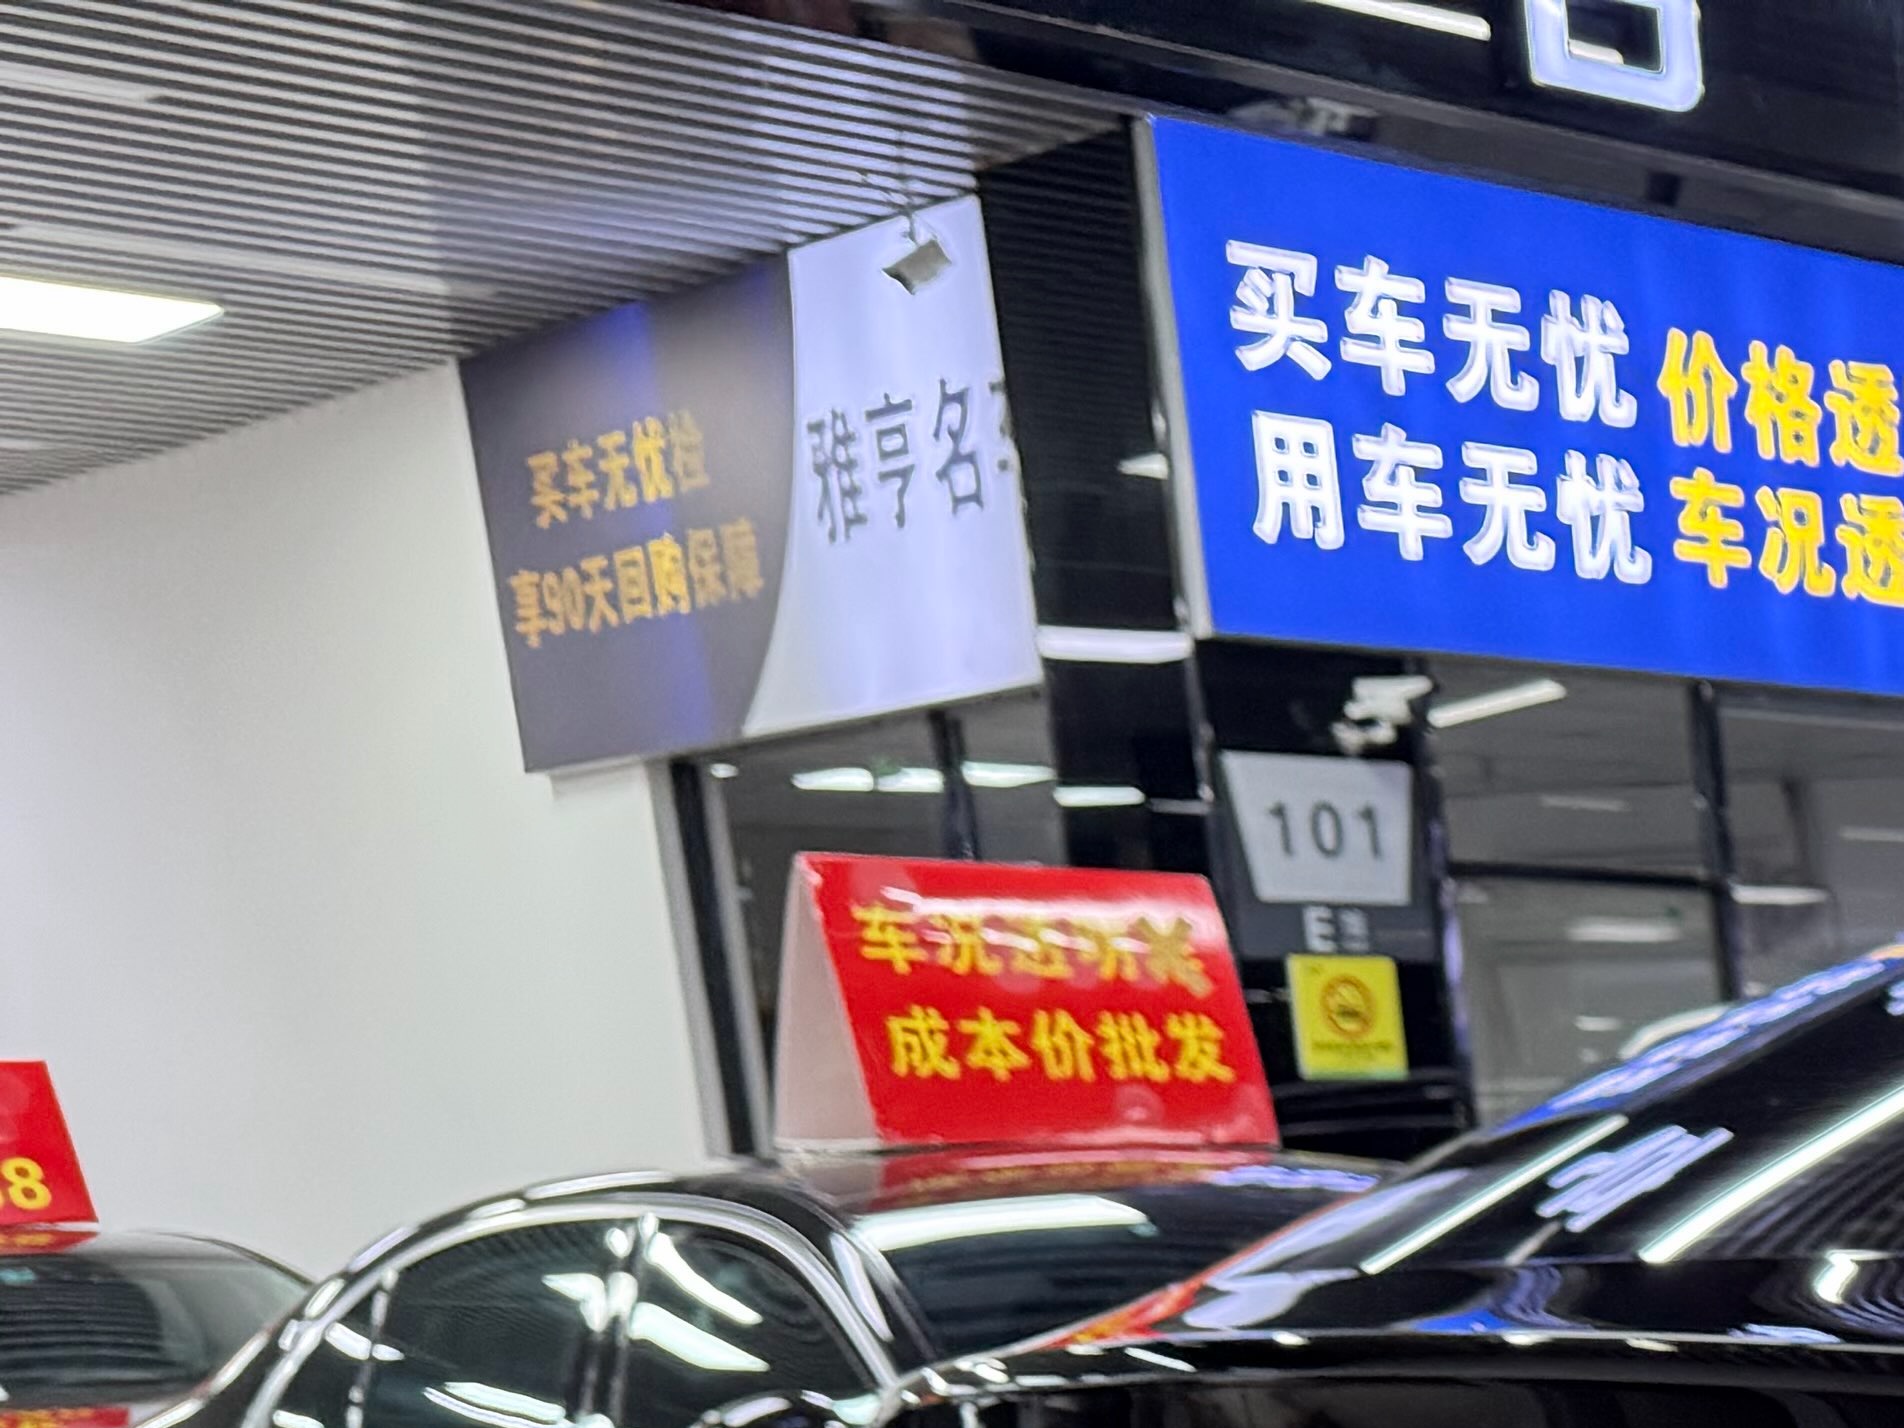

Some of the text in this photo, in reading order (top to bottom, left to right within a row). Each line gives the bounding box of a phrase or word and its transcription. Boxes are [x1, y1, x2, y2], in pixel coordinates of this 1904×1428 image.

[1226, 239, 1637, 428] 买车无忧
[807, 377, 1009, 543] 雅亨名
[1252, 409, 1653, 584] 用车无忧
[1266, 800, 1383, 859] 101
[885, 1003, 1236, 1083] 成本价批发
[0, 1156, 52, 1211] 8
